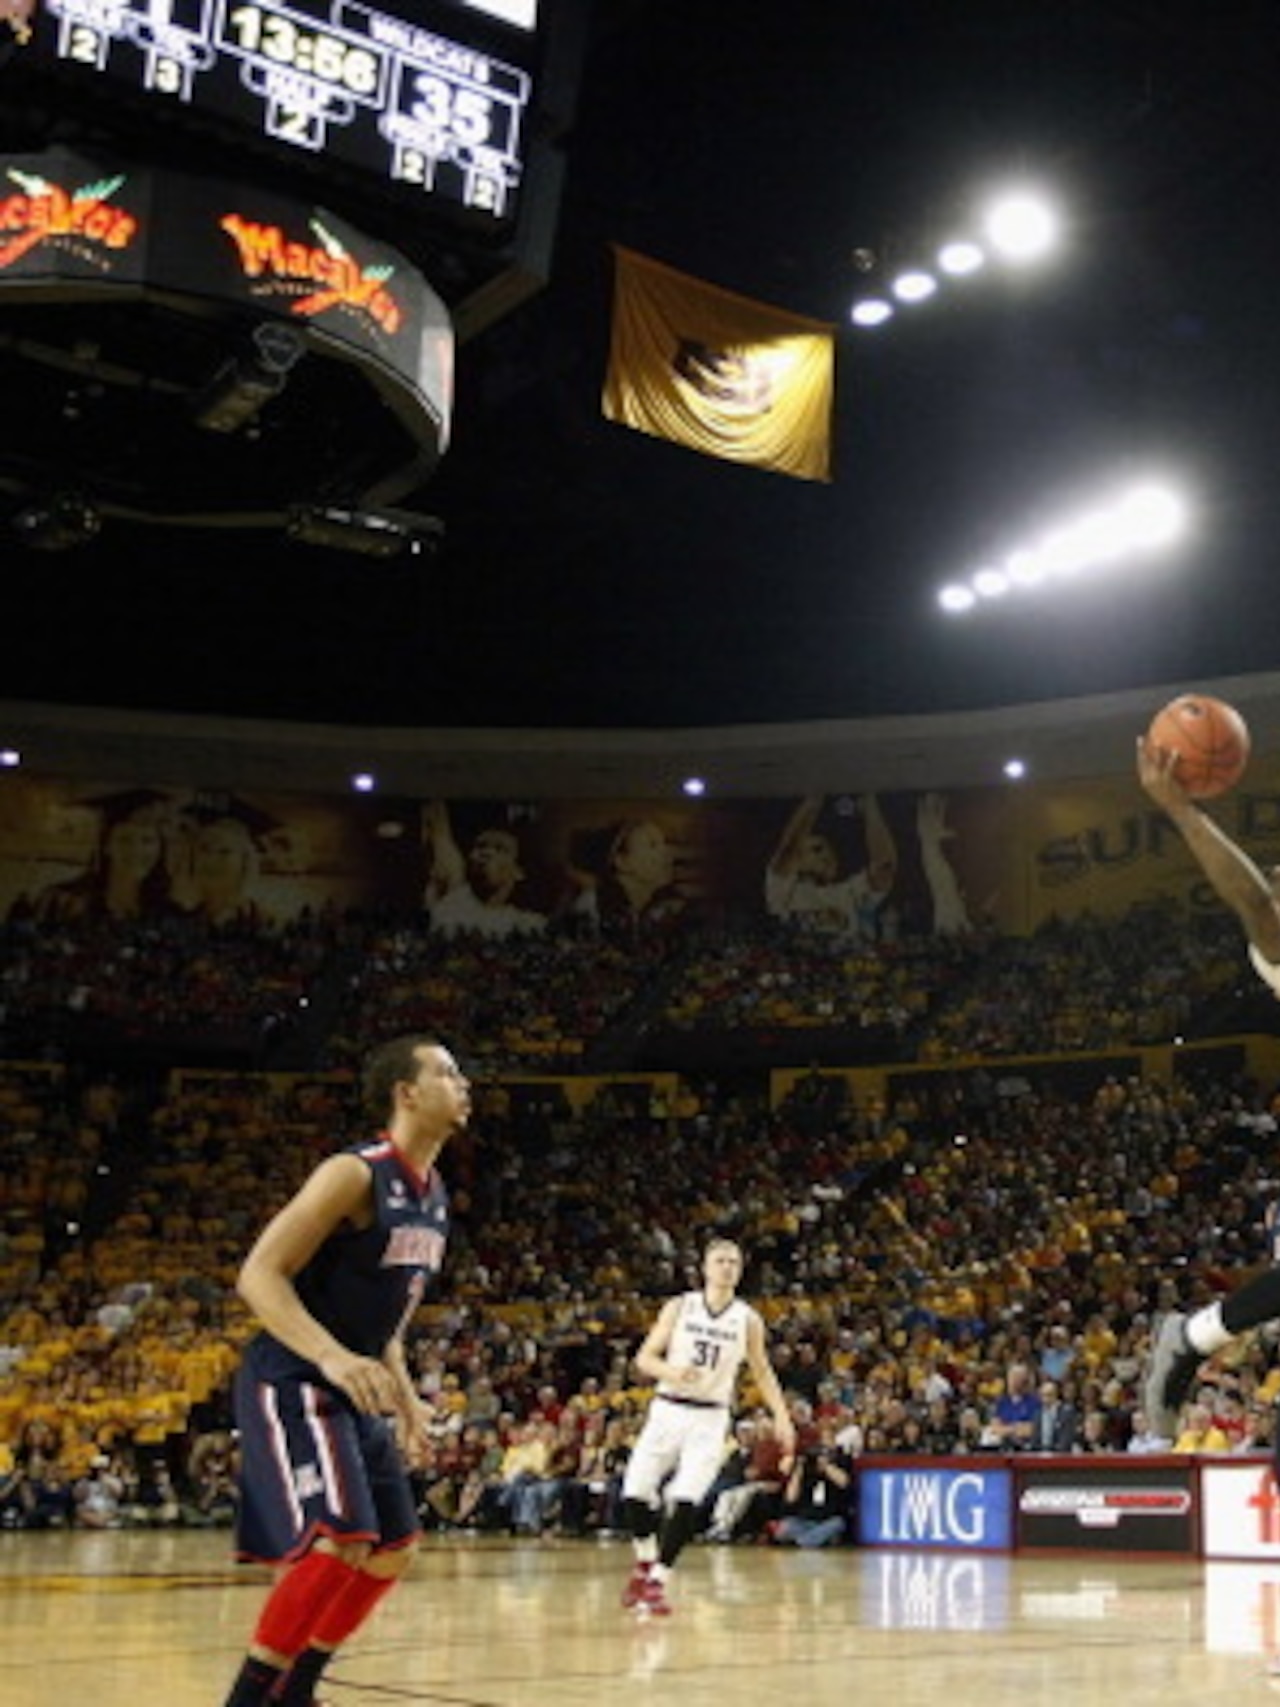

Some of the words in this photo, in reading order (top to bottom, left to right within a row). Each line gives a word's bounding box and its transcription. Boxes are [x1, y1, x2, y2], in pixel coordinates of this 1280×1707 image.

[231, 7, 378, 94] 13:56
[368, 14, 490, 83] WILDCATS
[411, 74, 492, 145] 35
[693, 1341, 720, 1371] 31
[879, 1472, 985, 1544] IMG
